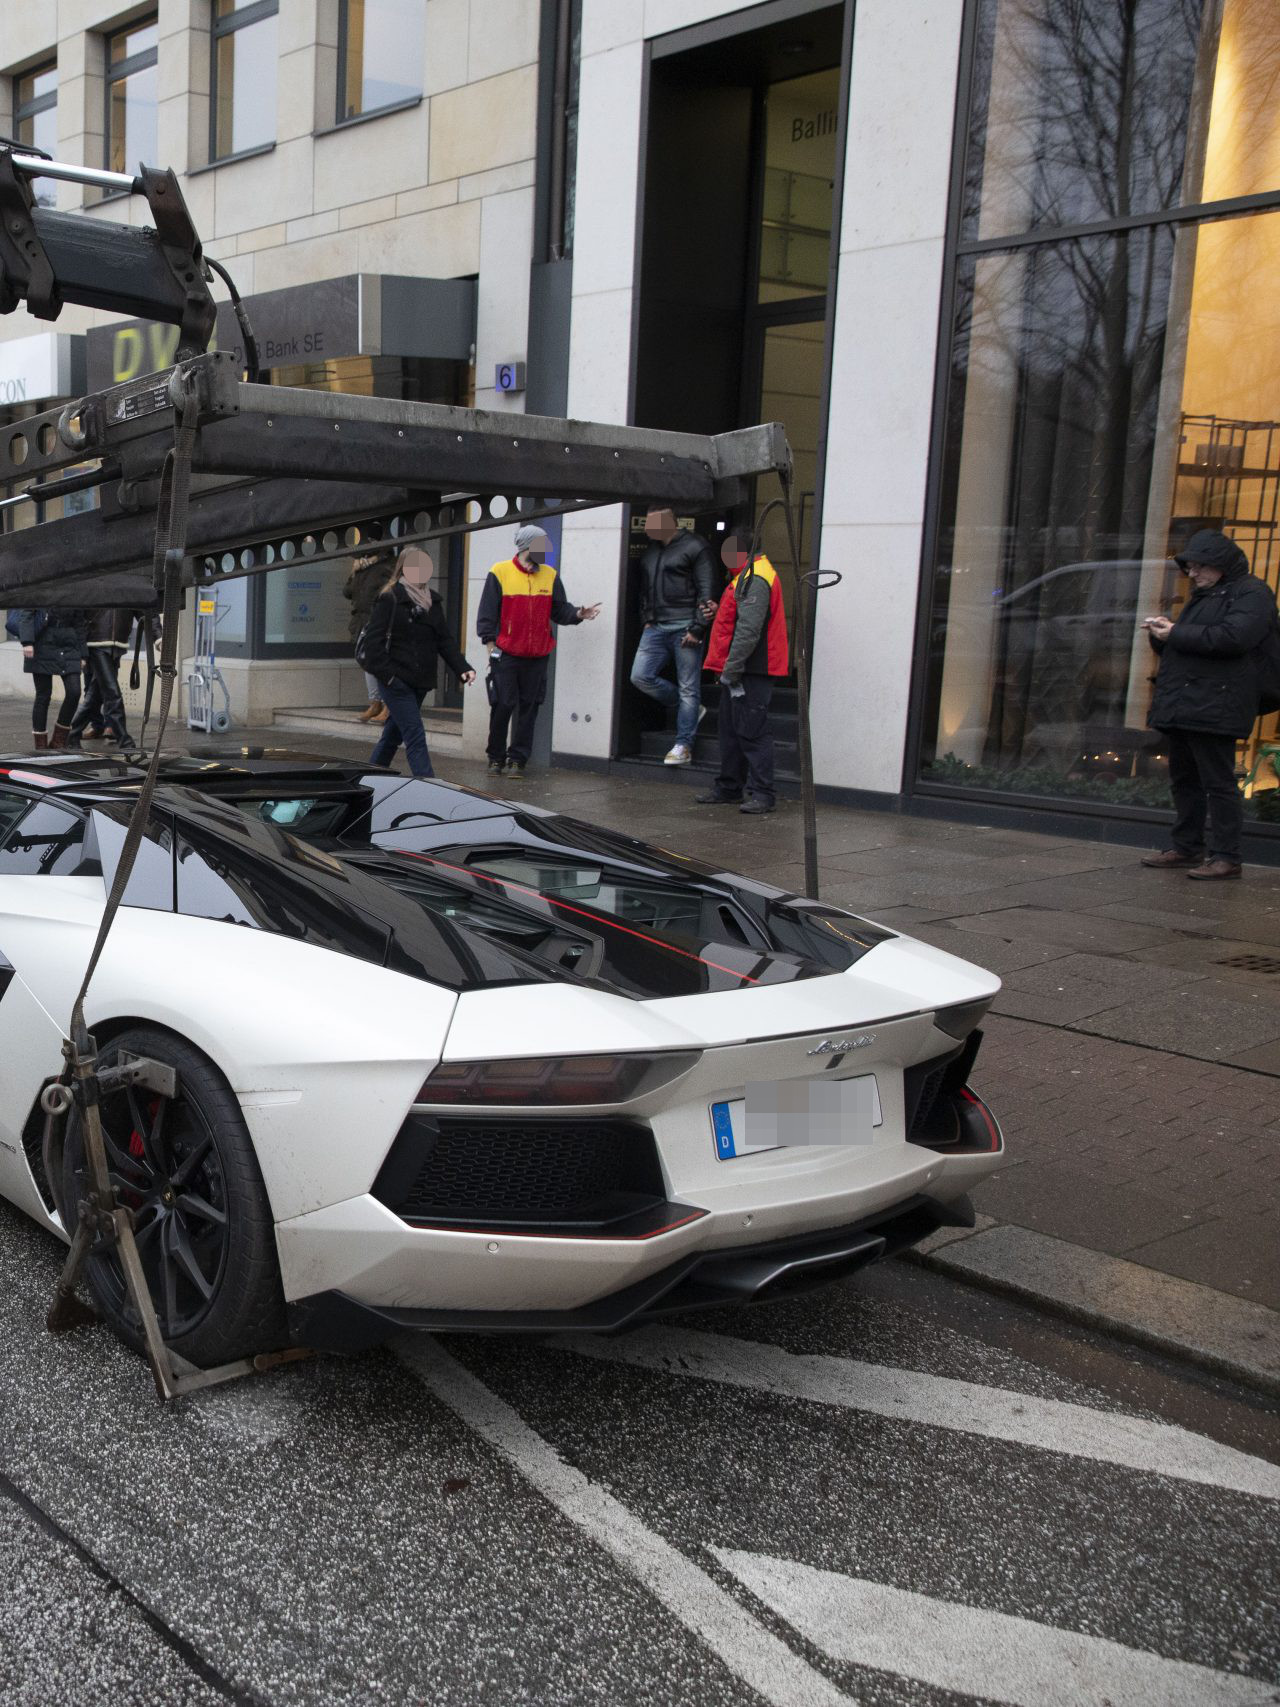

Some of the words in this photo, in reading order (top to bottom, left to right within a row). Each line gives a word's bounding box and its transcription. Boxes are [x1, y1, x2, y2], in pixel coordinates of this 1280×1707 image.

[792, 109, 838, 142] Balli
[266, 337, 298, 359] Bank
[304, 332, 323, 351] SE
[500, 365, 512, 389] 6
[721, 1136, 729, 1148] D
